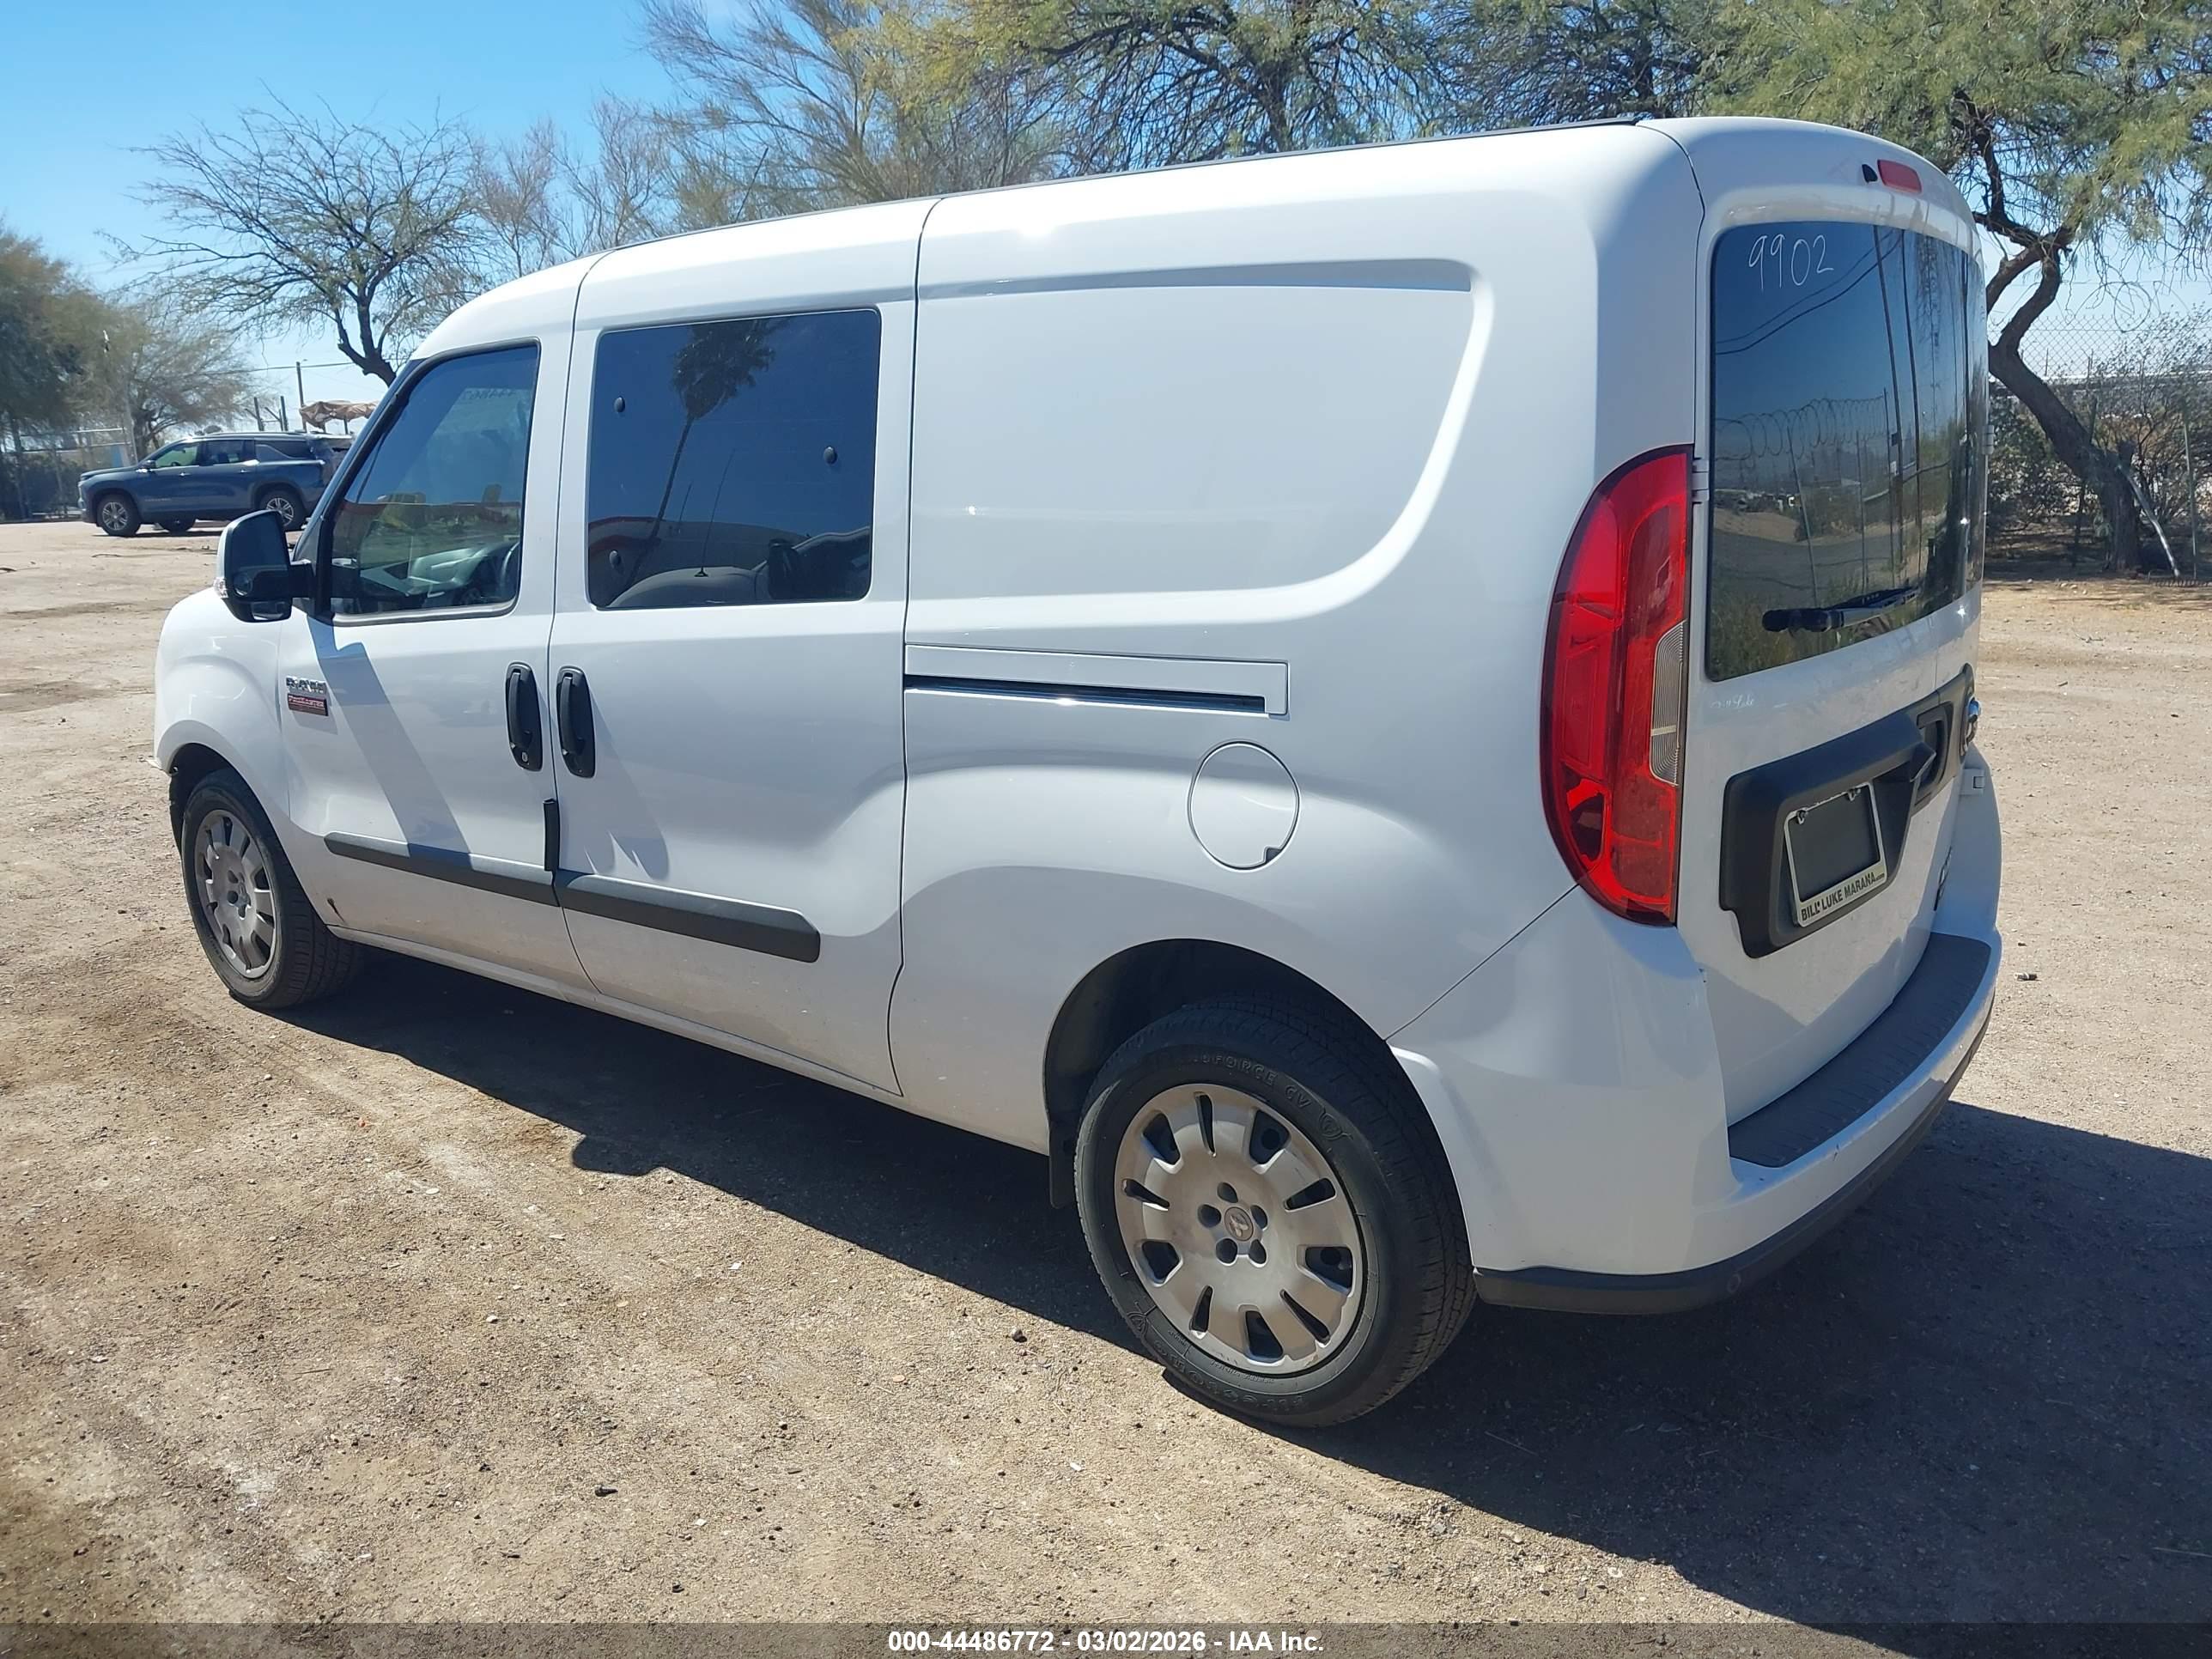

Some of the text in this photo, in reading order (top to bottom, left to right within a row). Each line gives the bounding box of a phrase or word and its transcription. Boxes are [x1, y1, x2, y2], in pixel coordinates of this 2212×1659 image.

[1748, 234, 1835, 293] 9902
[1801, 901, 1820, 921] BILL
[1821, 890, 1844, 911] LUKE
